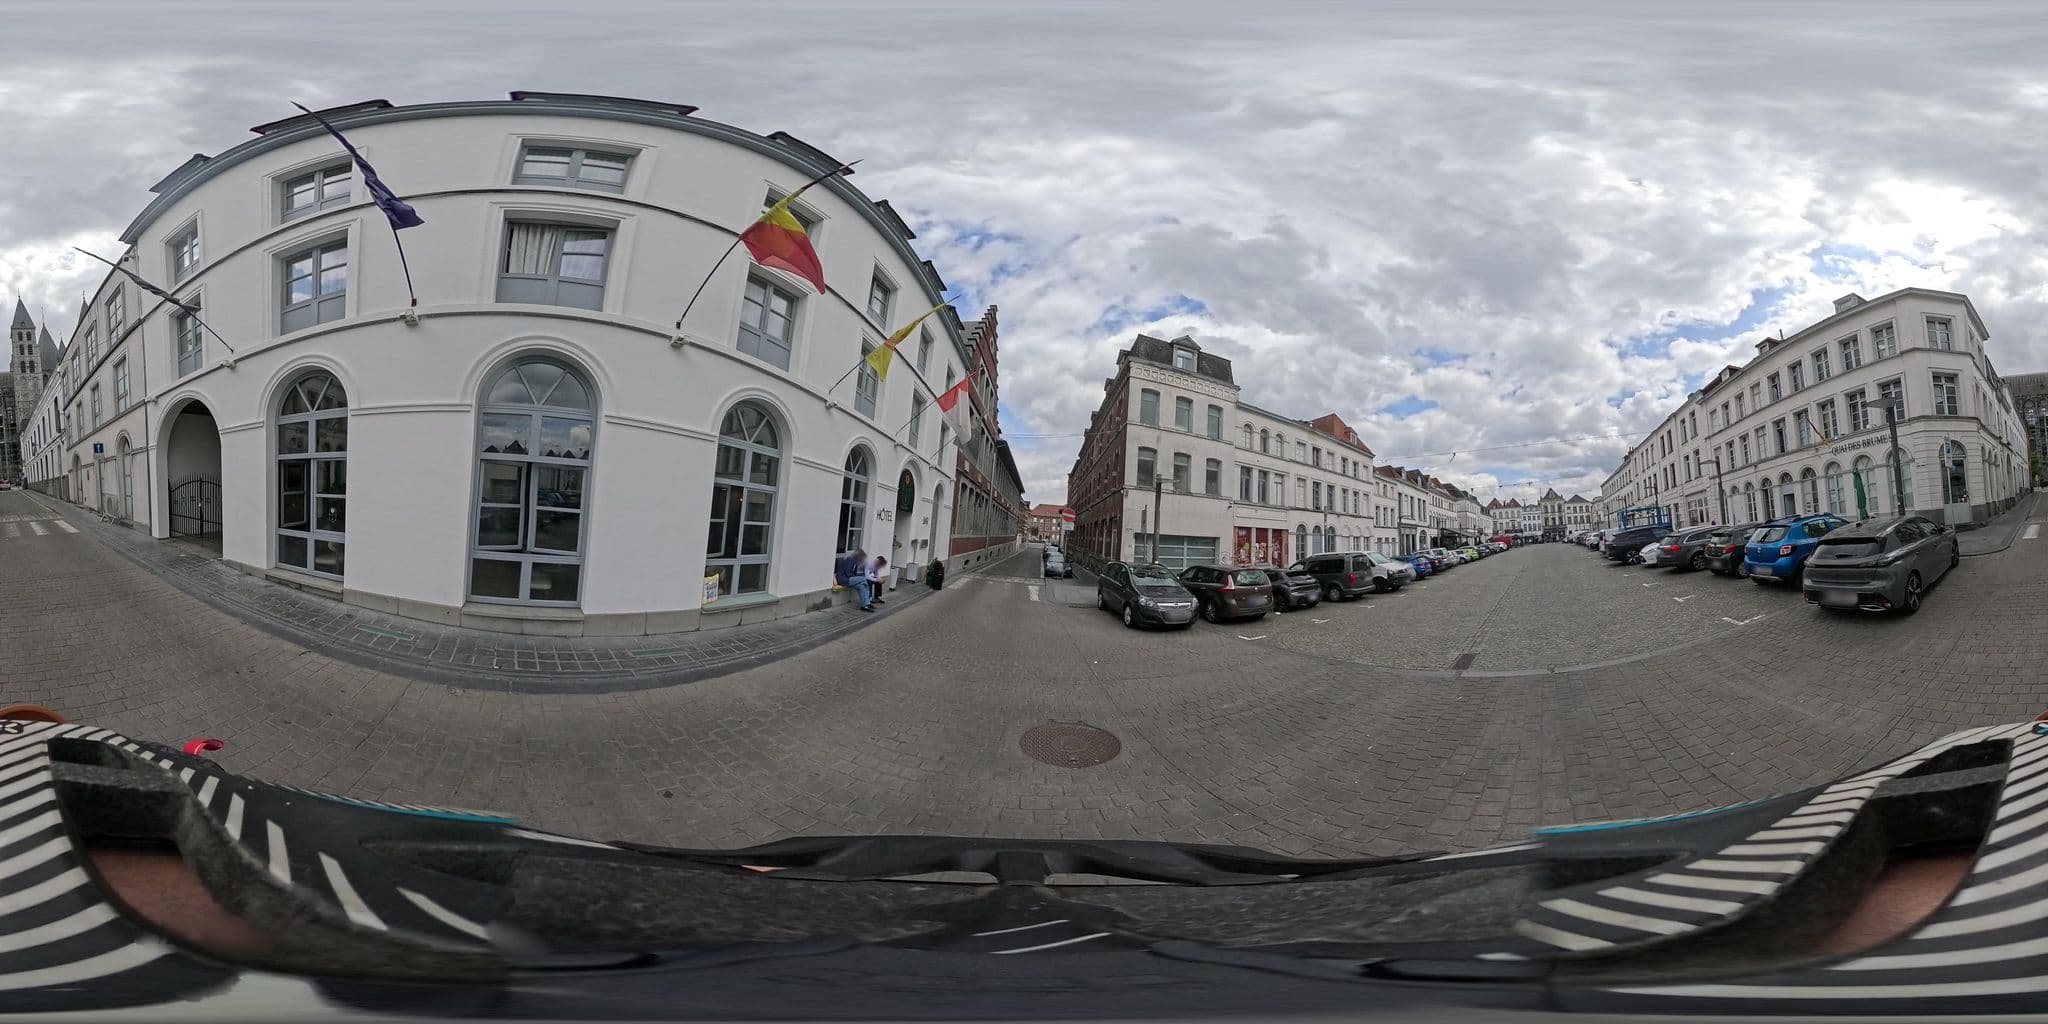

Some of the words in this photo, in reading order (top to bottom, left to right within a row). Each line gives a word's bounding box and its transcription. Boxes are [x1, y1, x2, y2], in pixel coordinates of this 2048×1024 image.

[1831, 444, 1847, 456] QUAI
[1848, 441, 1860, 451] DES
[876, 508, 893, 521] HÔTEL
